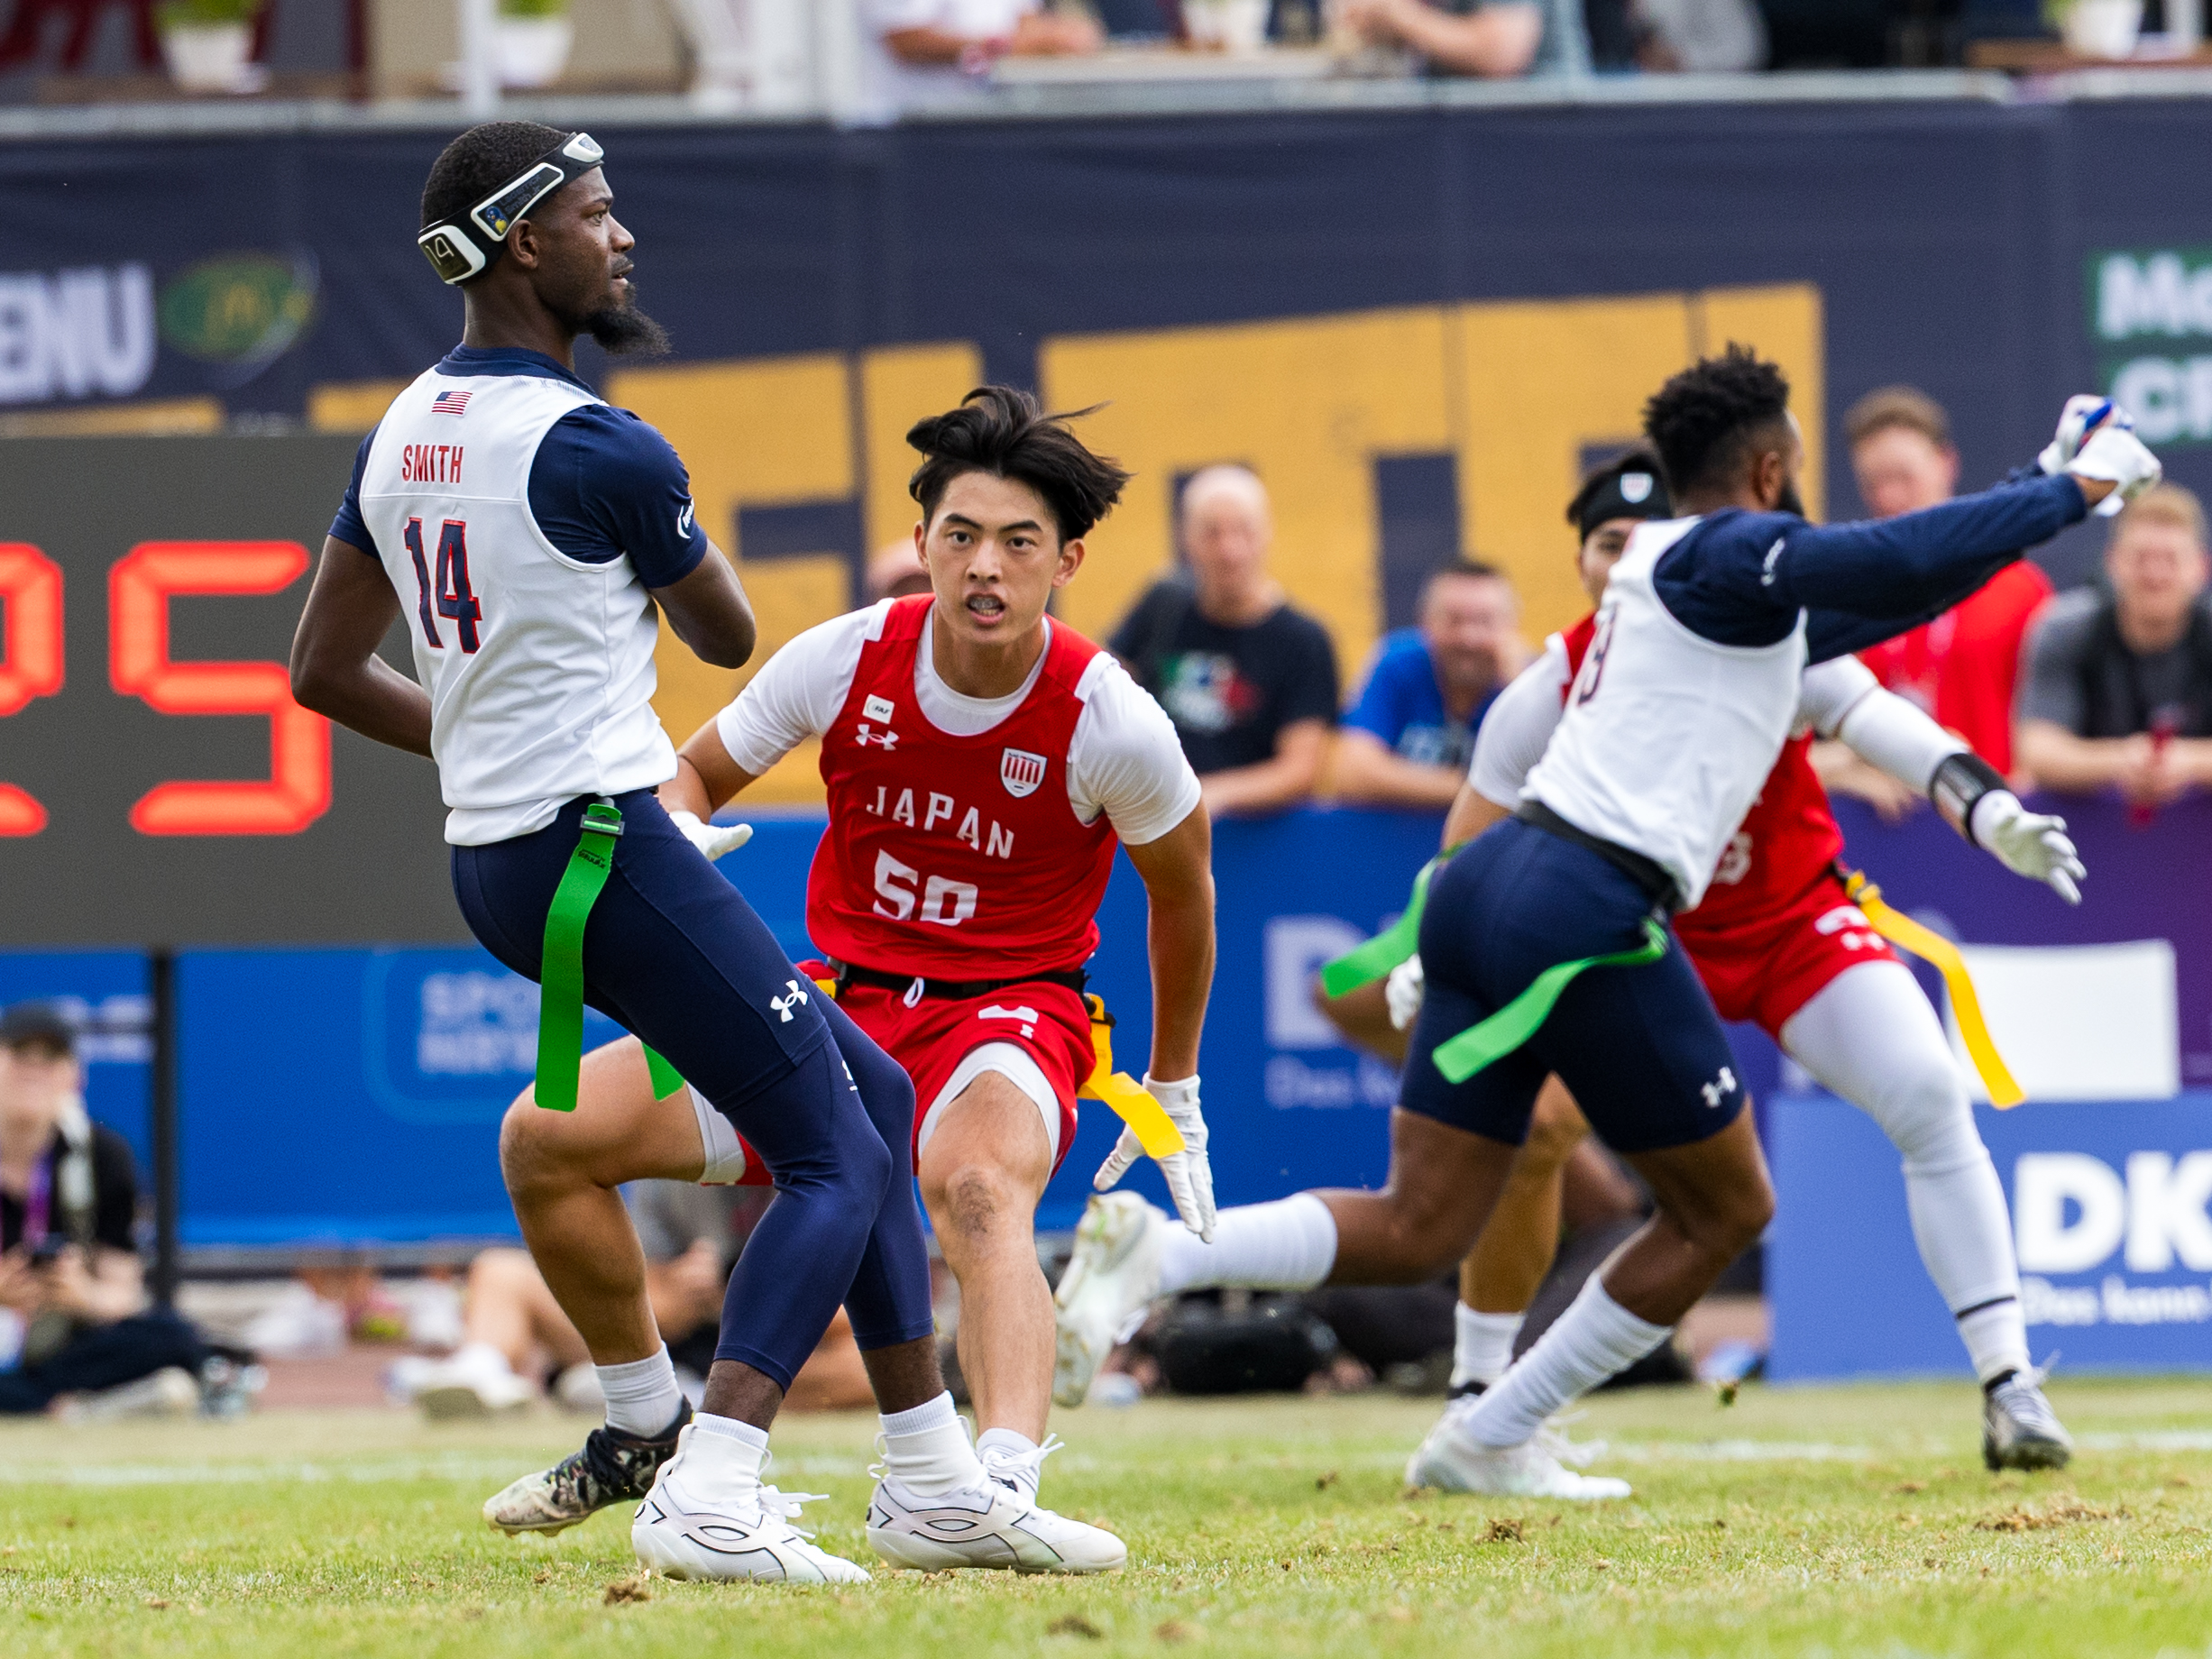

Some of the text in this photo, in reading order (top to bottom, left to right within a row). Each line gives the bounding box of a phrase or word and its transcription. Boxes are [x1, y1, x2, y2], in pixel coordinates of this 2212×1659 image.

[425, 236, 454, 266] 14
[402, 444, 464, 484] SMITH
[403, 517, 482, 655] 14
[0, 539, 332, 837] 5
[866, 785, 1015, 860] JAPAN
[872, 848, 979, 927] 50
